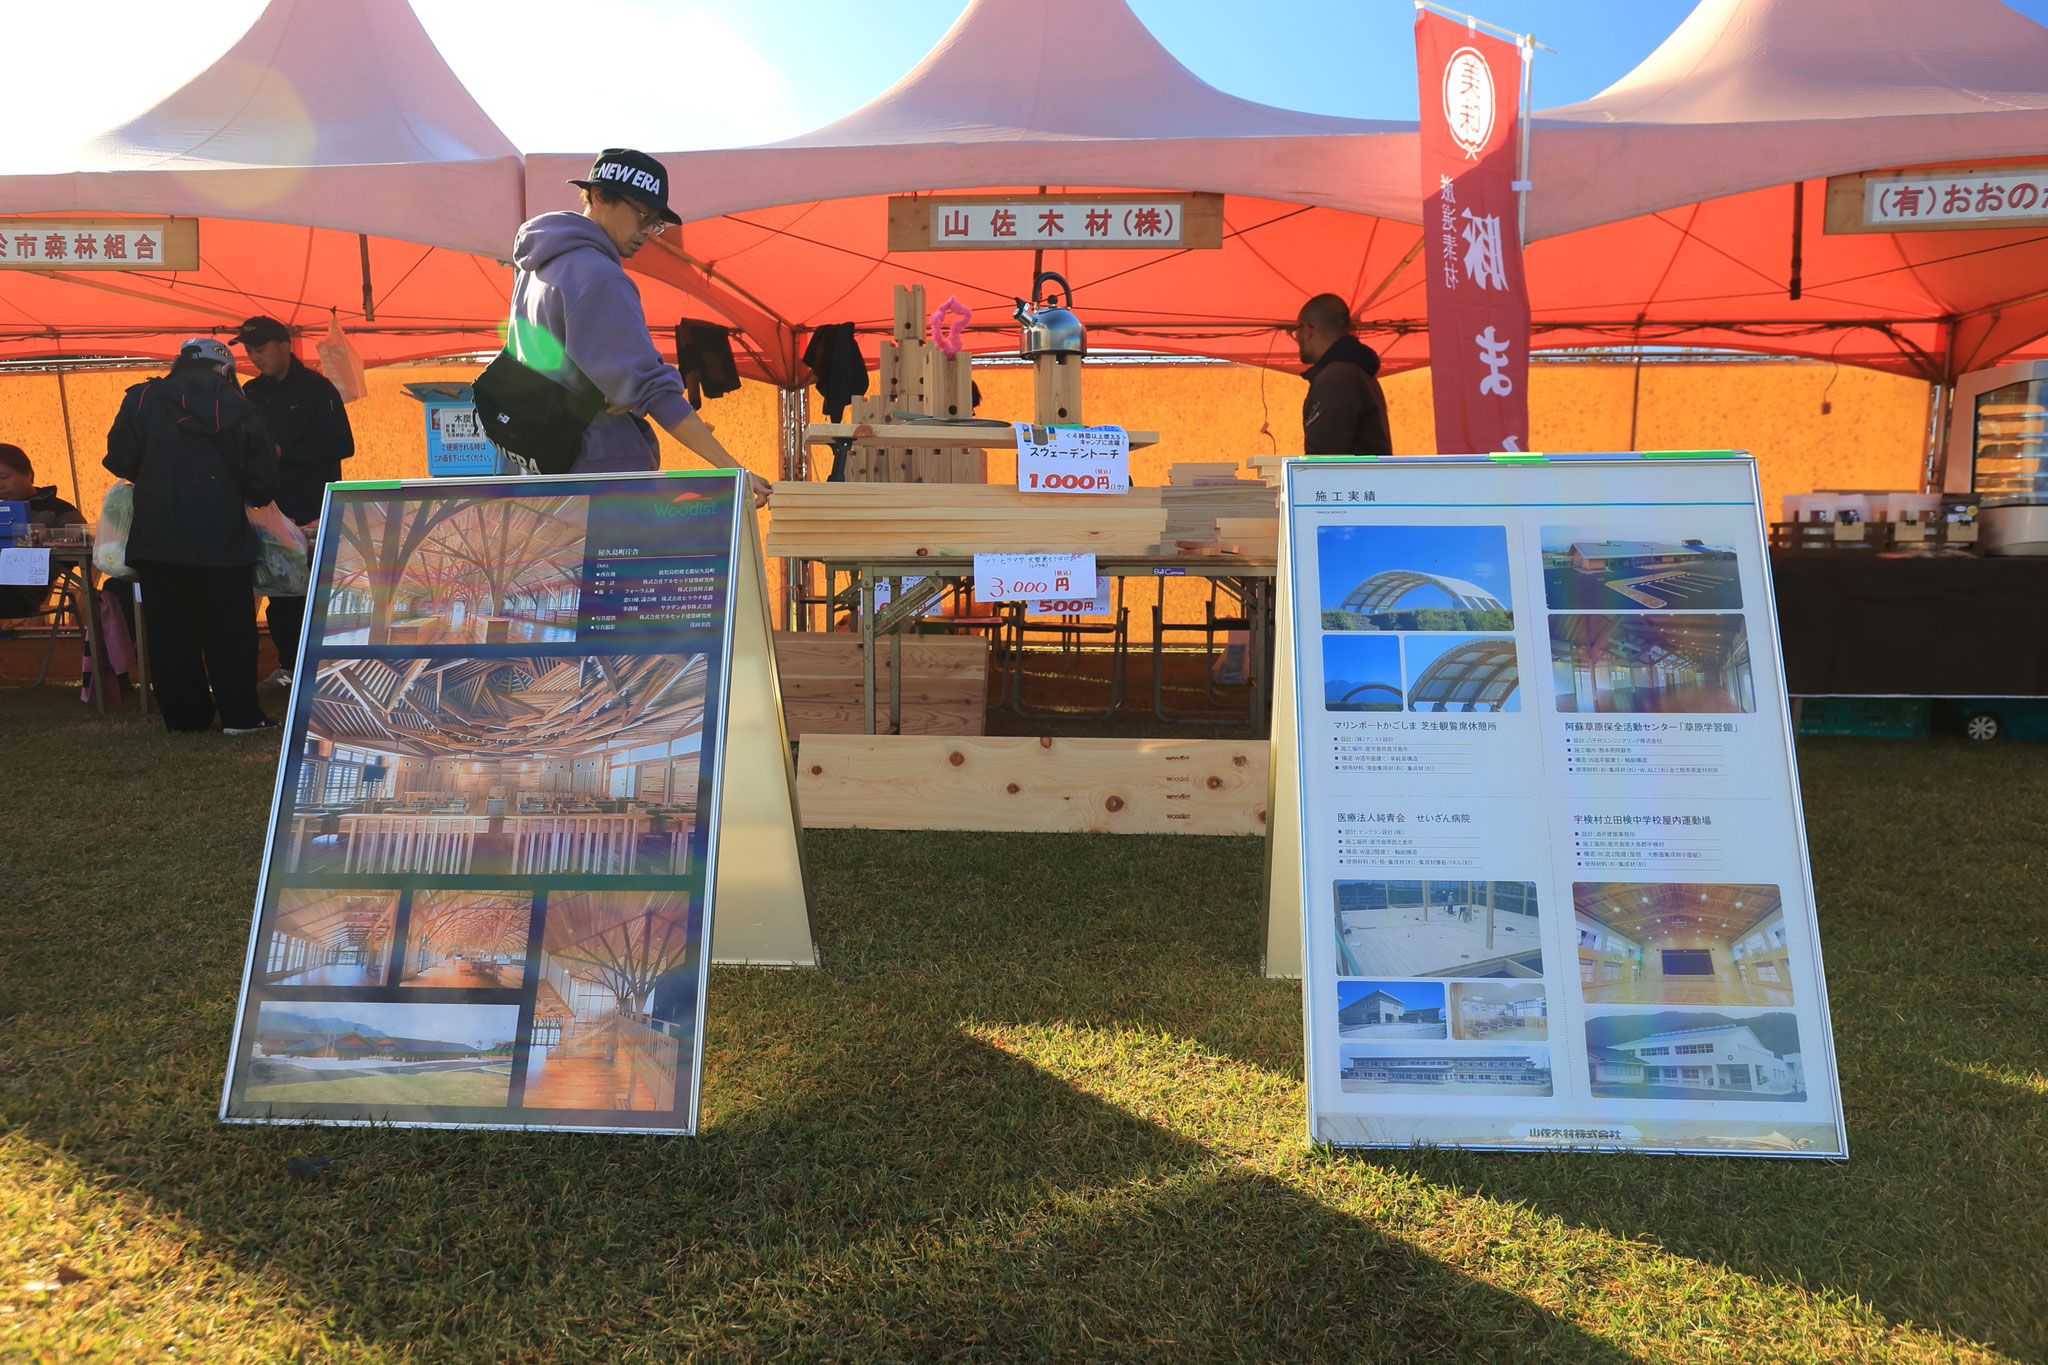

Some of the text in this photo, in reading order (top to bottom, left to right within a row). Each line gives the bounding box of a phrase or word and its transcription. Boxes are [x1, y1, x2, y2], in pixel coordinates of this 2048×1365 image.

[597, 162, 661, 195] NEW ERA
[943, 208, 1174, 237] 山佐木材(株)
[1030, 446, 1120, 459] スウェーデントーチ
[1315, 490, 1377, 502] 施工実績
[654, 501, 718, 517] Woodist
[598, 547, 640, 557] 屋久島町庁舎
[1039, 599, 1094, 613] 500円
[1334, 720, 1498, 732] マリンポートかごしま 芝生観覧席休憩所
[1565, 721, 1739, 733] 阿蘇草原保全活動センター「草原学習館」
[1337, 812, 1472, 824] 医療法人純青会 せいざん病院
[1573, 814, 1712, 826] 宇検村立田検中学校屋内運動場
[1529, 1127, 1622, 1140] 山佐木材株式会社
